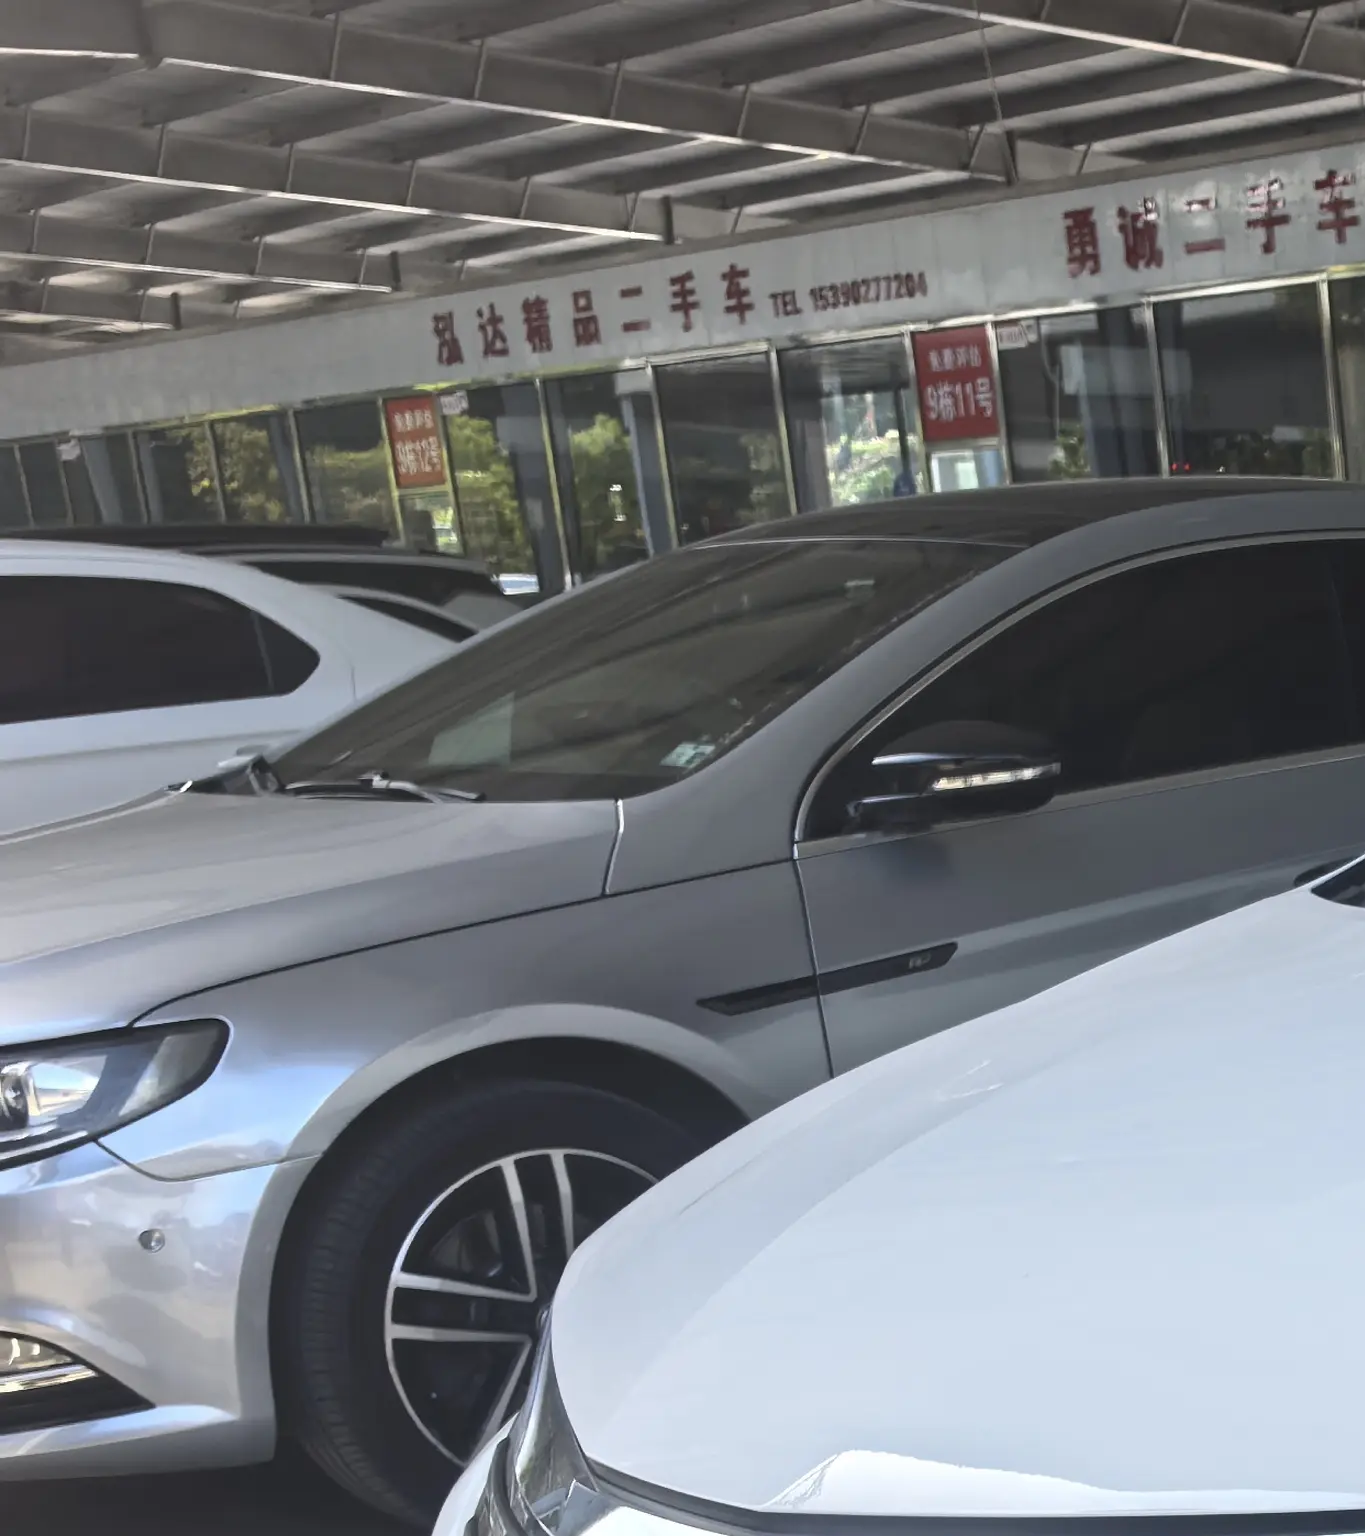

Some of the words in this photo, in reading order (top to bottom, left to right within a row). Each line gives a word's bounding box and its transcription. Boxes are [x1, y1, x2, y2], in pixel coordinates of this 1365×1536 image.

[433, 263, 755, 365] 泓达精品二手车
